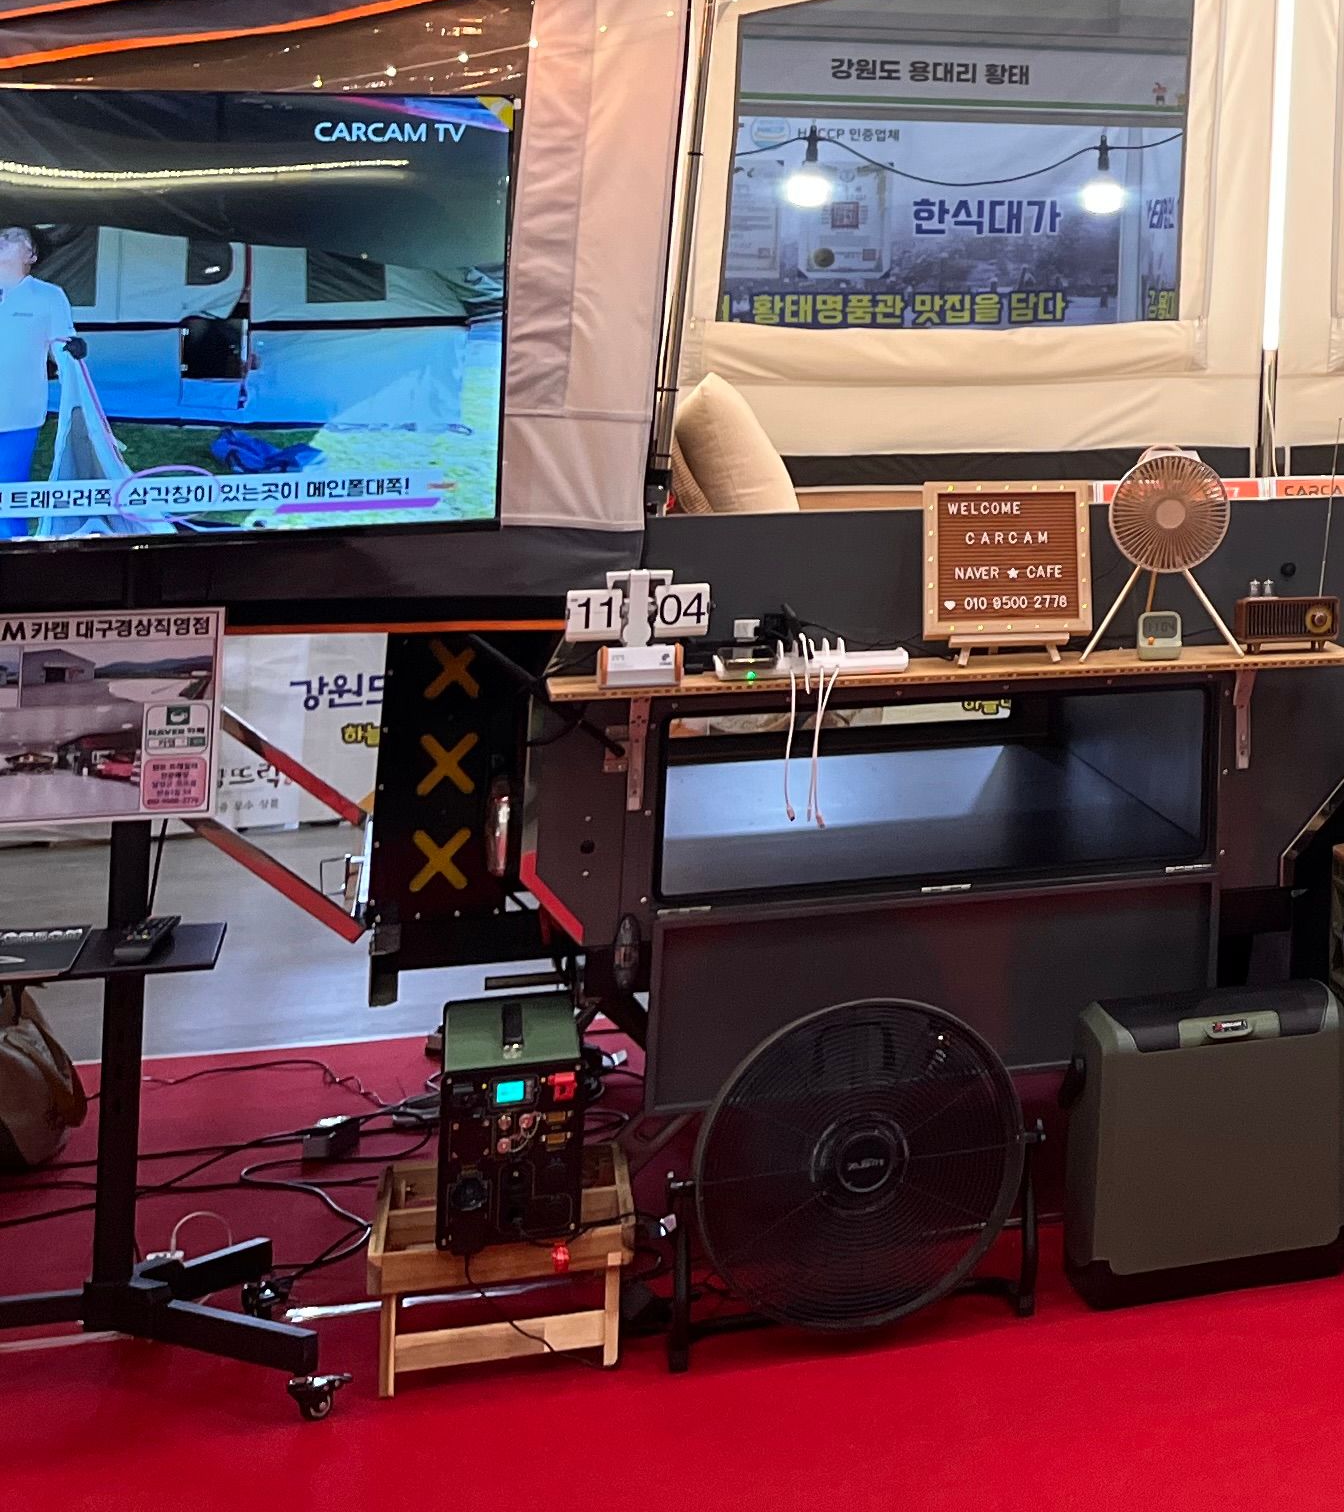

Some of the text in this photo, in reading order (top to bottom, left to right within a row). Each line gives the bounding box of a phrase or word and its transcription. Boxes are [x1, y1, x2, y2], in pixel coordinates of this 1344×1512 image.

[831, 58, 1030, 85] 강원도 용대리 황태
[314, 122, 466, 143] CARCAM TV
[798, 127, 899, 142] HCCP 인증업체
[912, 197, 1062, 235] 한식대가
[753, 292, 1065, 325] 황태명품관 맛집을 담다
[948, 502, 1021, 515] WELCOME
[965, 531, 1048, 544] CARCAM
[954, 565, 1062, 579] NAVER CAFE
[577, 596, 613, 629] 11
[659, 592, 705, 625] 04
[964, 597, 987, 610] 010
[1033, 595, 1068, 608] 2778
[31, 621, 70, 640] 카캠
[76, 616, 209, 639] 대구경상직영점
